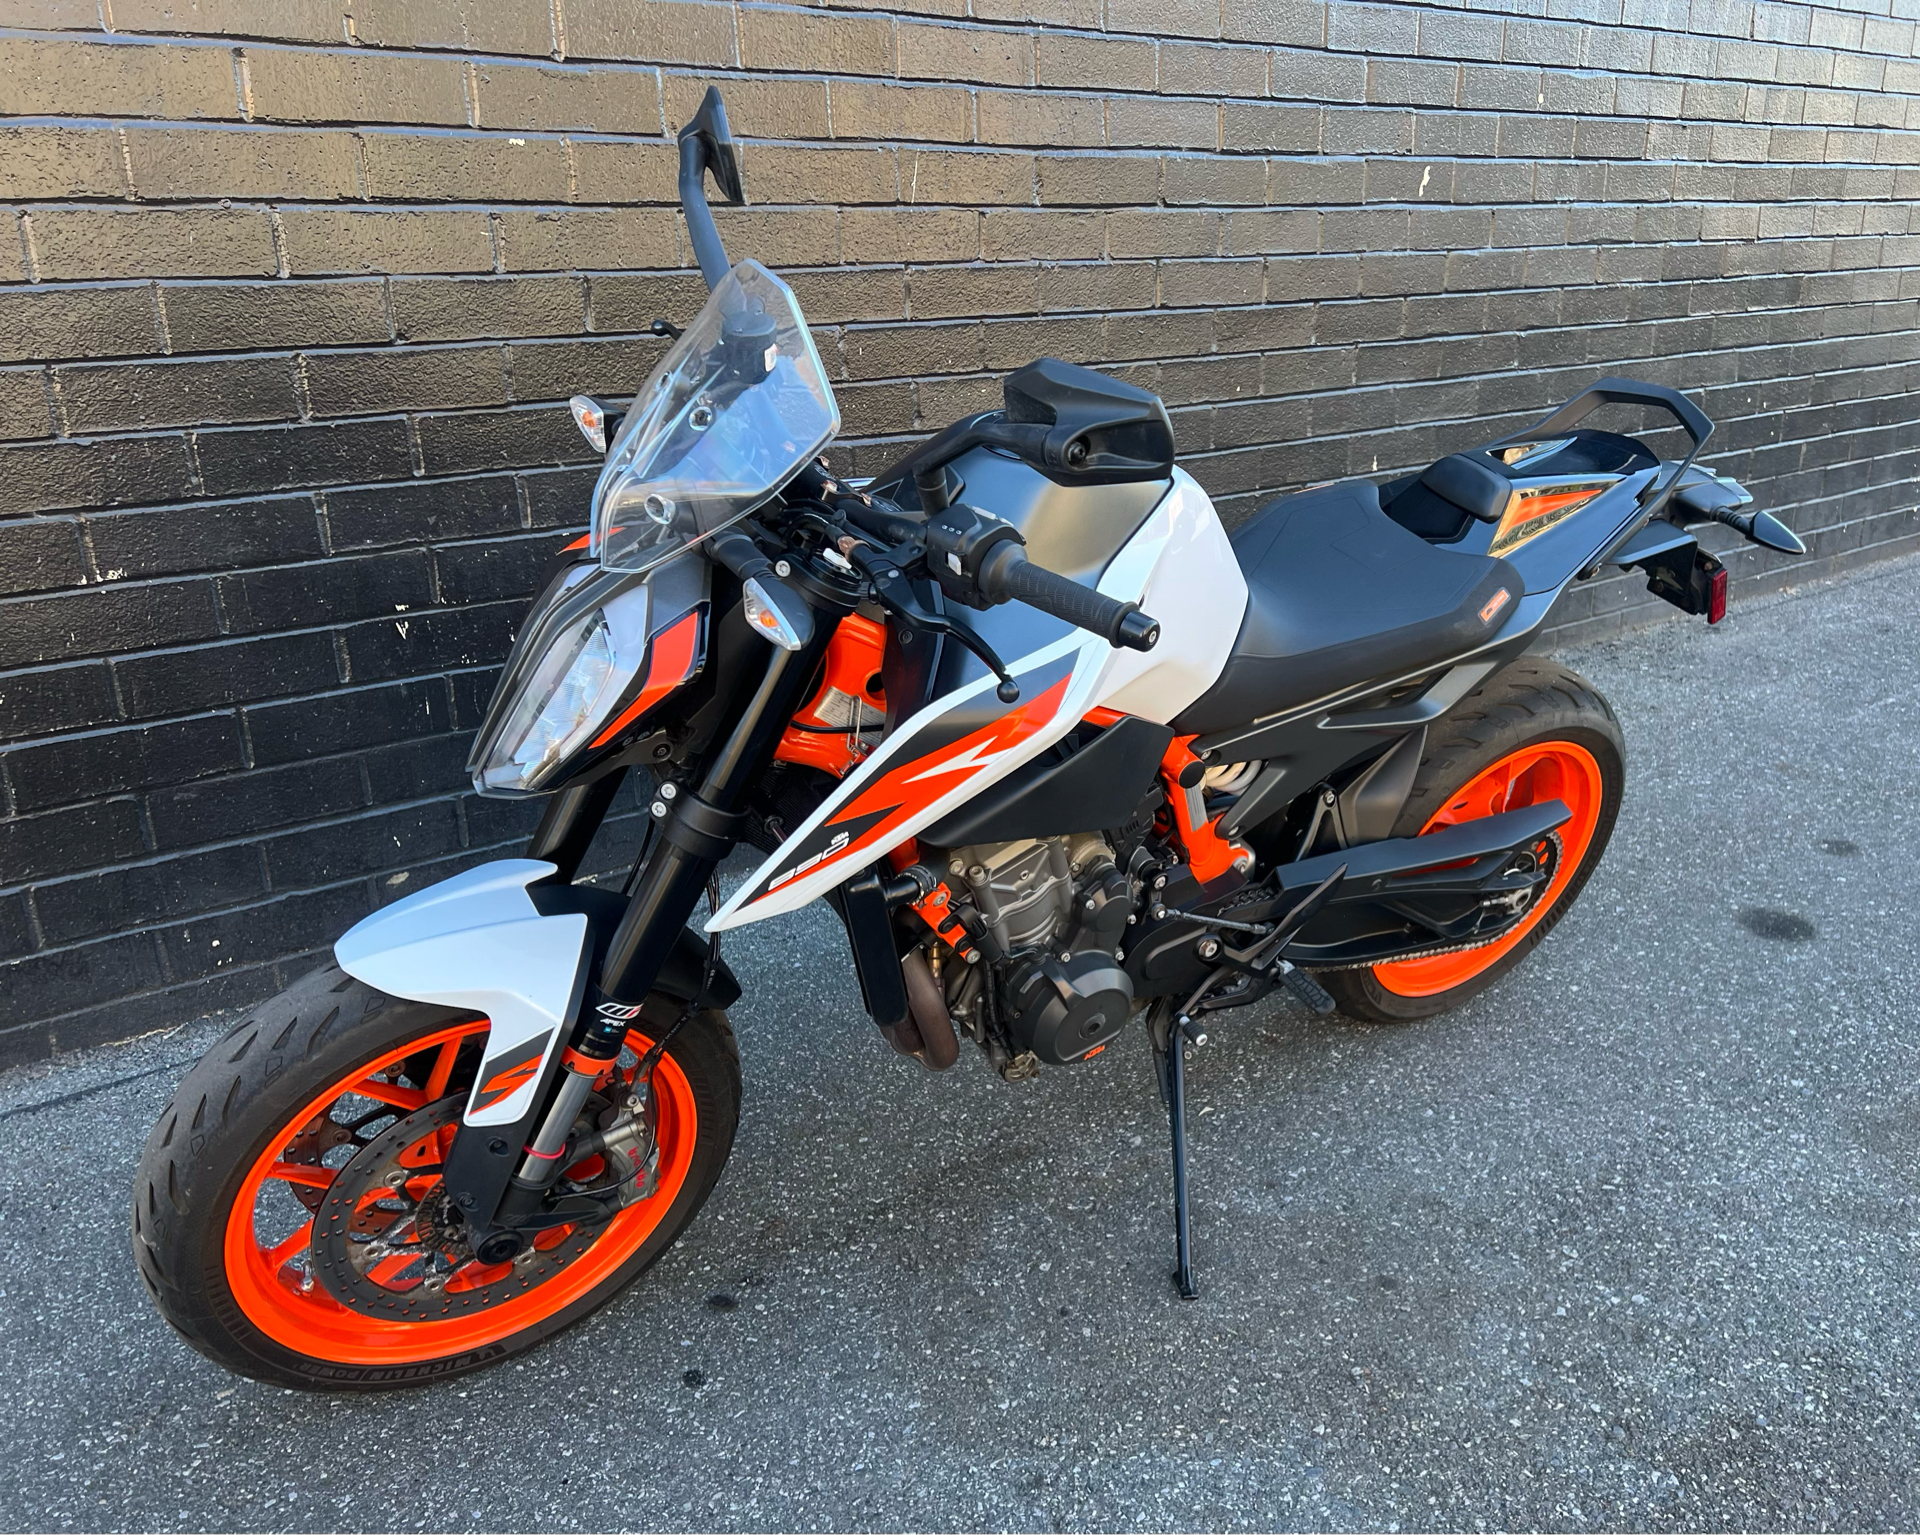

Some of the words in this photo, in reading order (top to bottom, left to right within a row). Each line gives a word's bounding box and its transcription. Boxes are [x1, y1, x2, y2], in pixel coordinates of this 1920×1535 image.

[600, 1018, 626, 1027] APEX
[300, 1363, 359, 1379] POWER
[369, 1355, 472, 1380] MICHELIN
